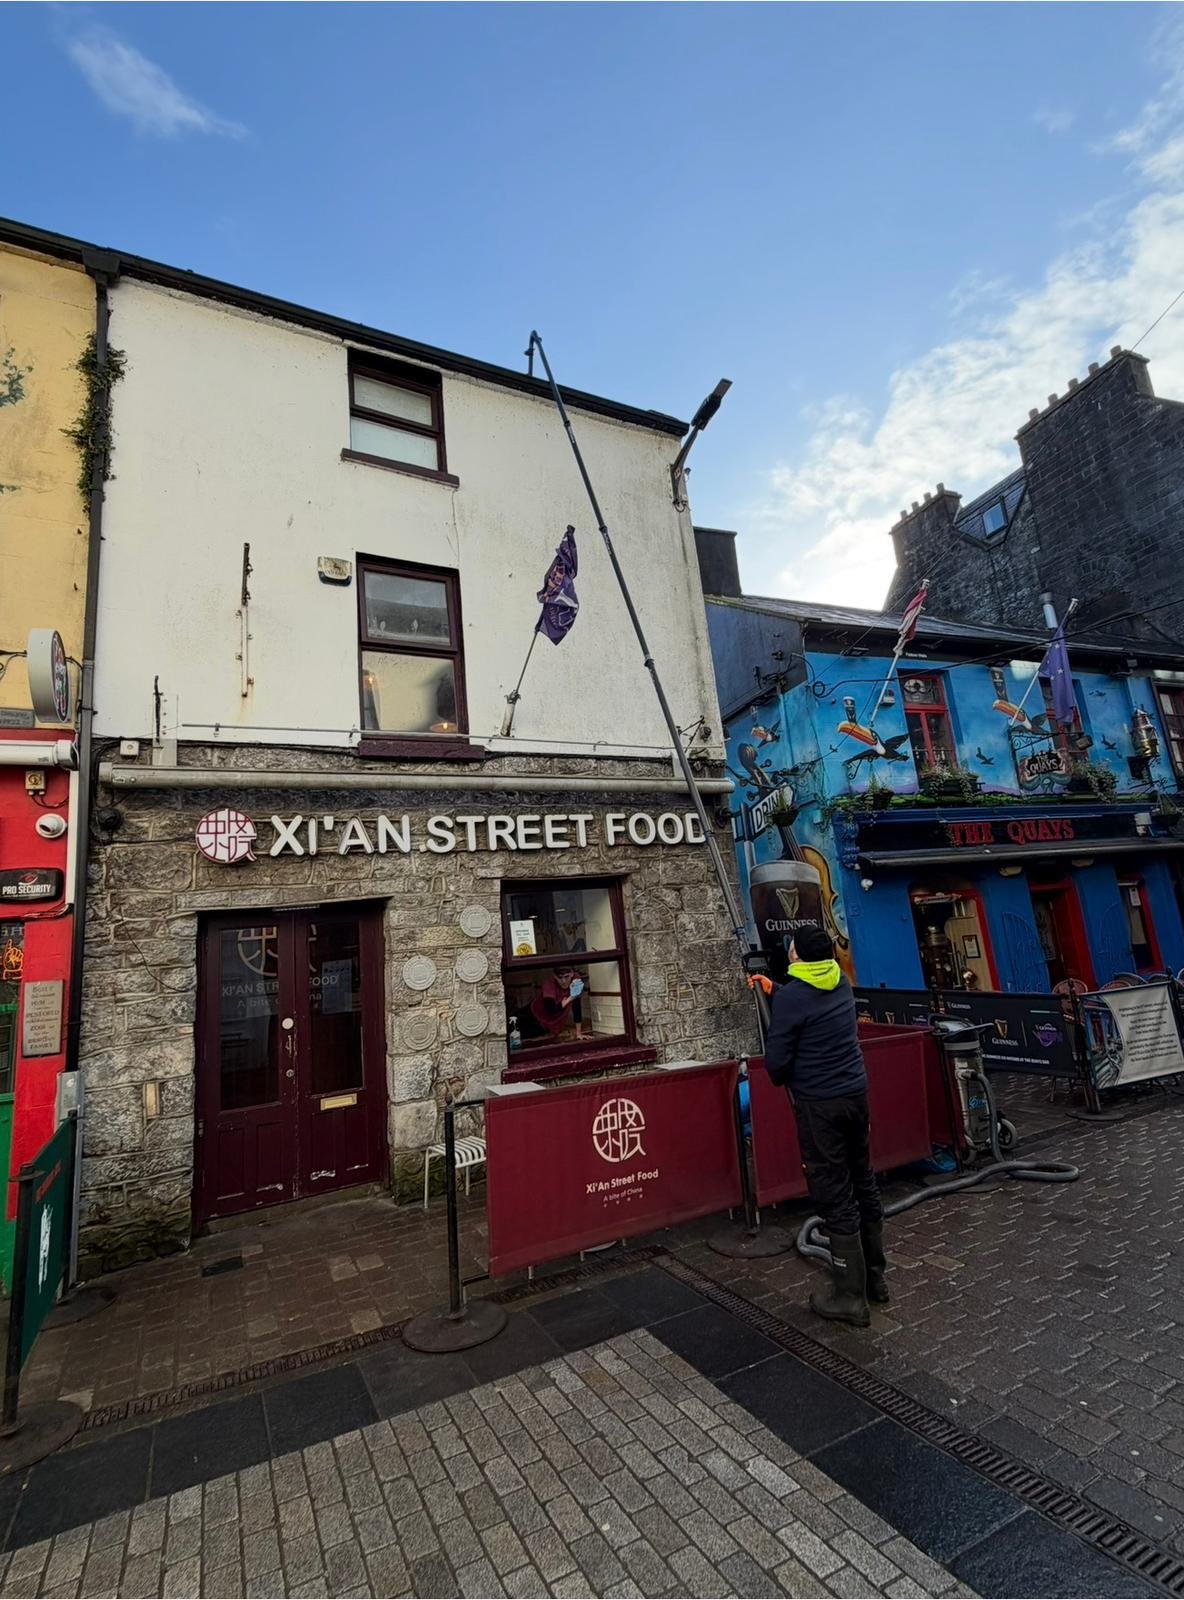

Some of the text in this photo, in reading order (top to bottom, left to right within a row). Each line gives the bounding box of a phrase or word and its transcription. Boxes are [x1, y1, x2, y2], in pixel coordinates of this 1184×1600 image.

[1030, 759, 1059, 774] QUAYS
[270, 812, 706, 857] XI'AN STREET FOOD
[946, 820, 1075, 848] THE QUAYS
[2, 883, 52, 895] PRO SECURITY
[222, 983, 253, 997] XI'AN
[586, 1168, 659, 1194] Xi'An Street Food
